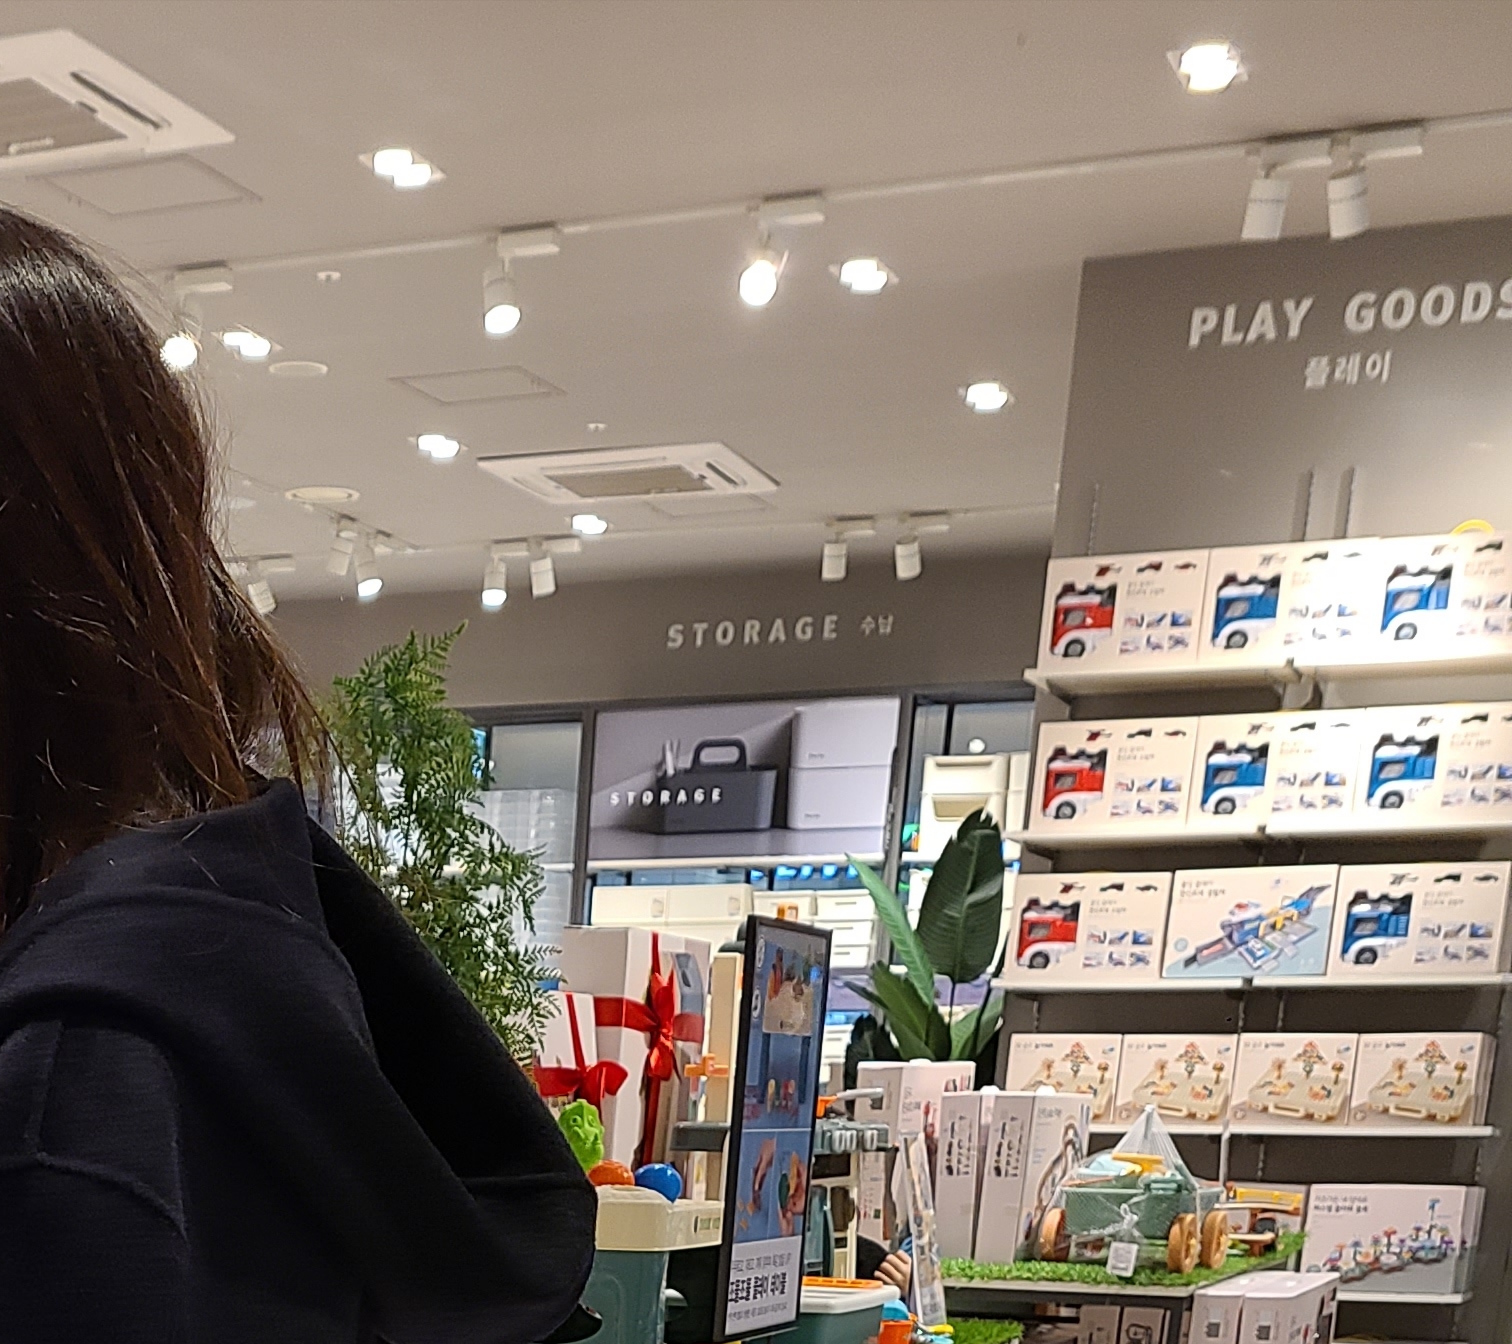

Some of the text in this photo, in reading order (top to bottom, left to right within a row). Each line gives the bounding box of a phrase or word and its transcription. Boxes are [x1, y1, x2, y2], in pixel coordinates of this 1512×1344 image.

[1188, 296, 1314, 349] PLAY
[666, 613, 839, 649] STORAGE
[609, 786, 721, 807] STORAGE
